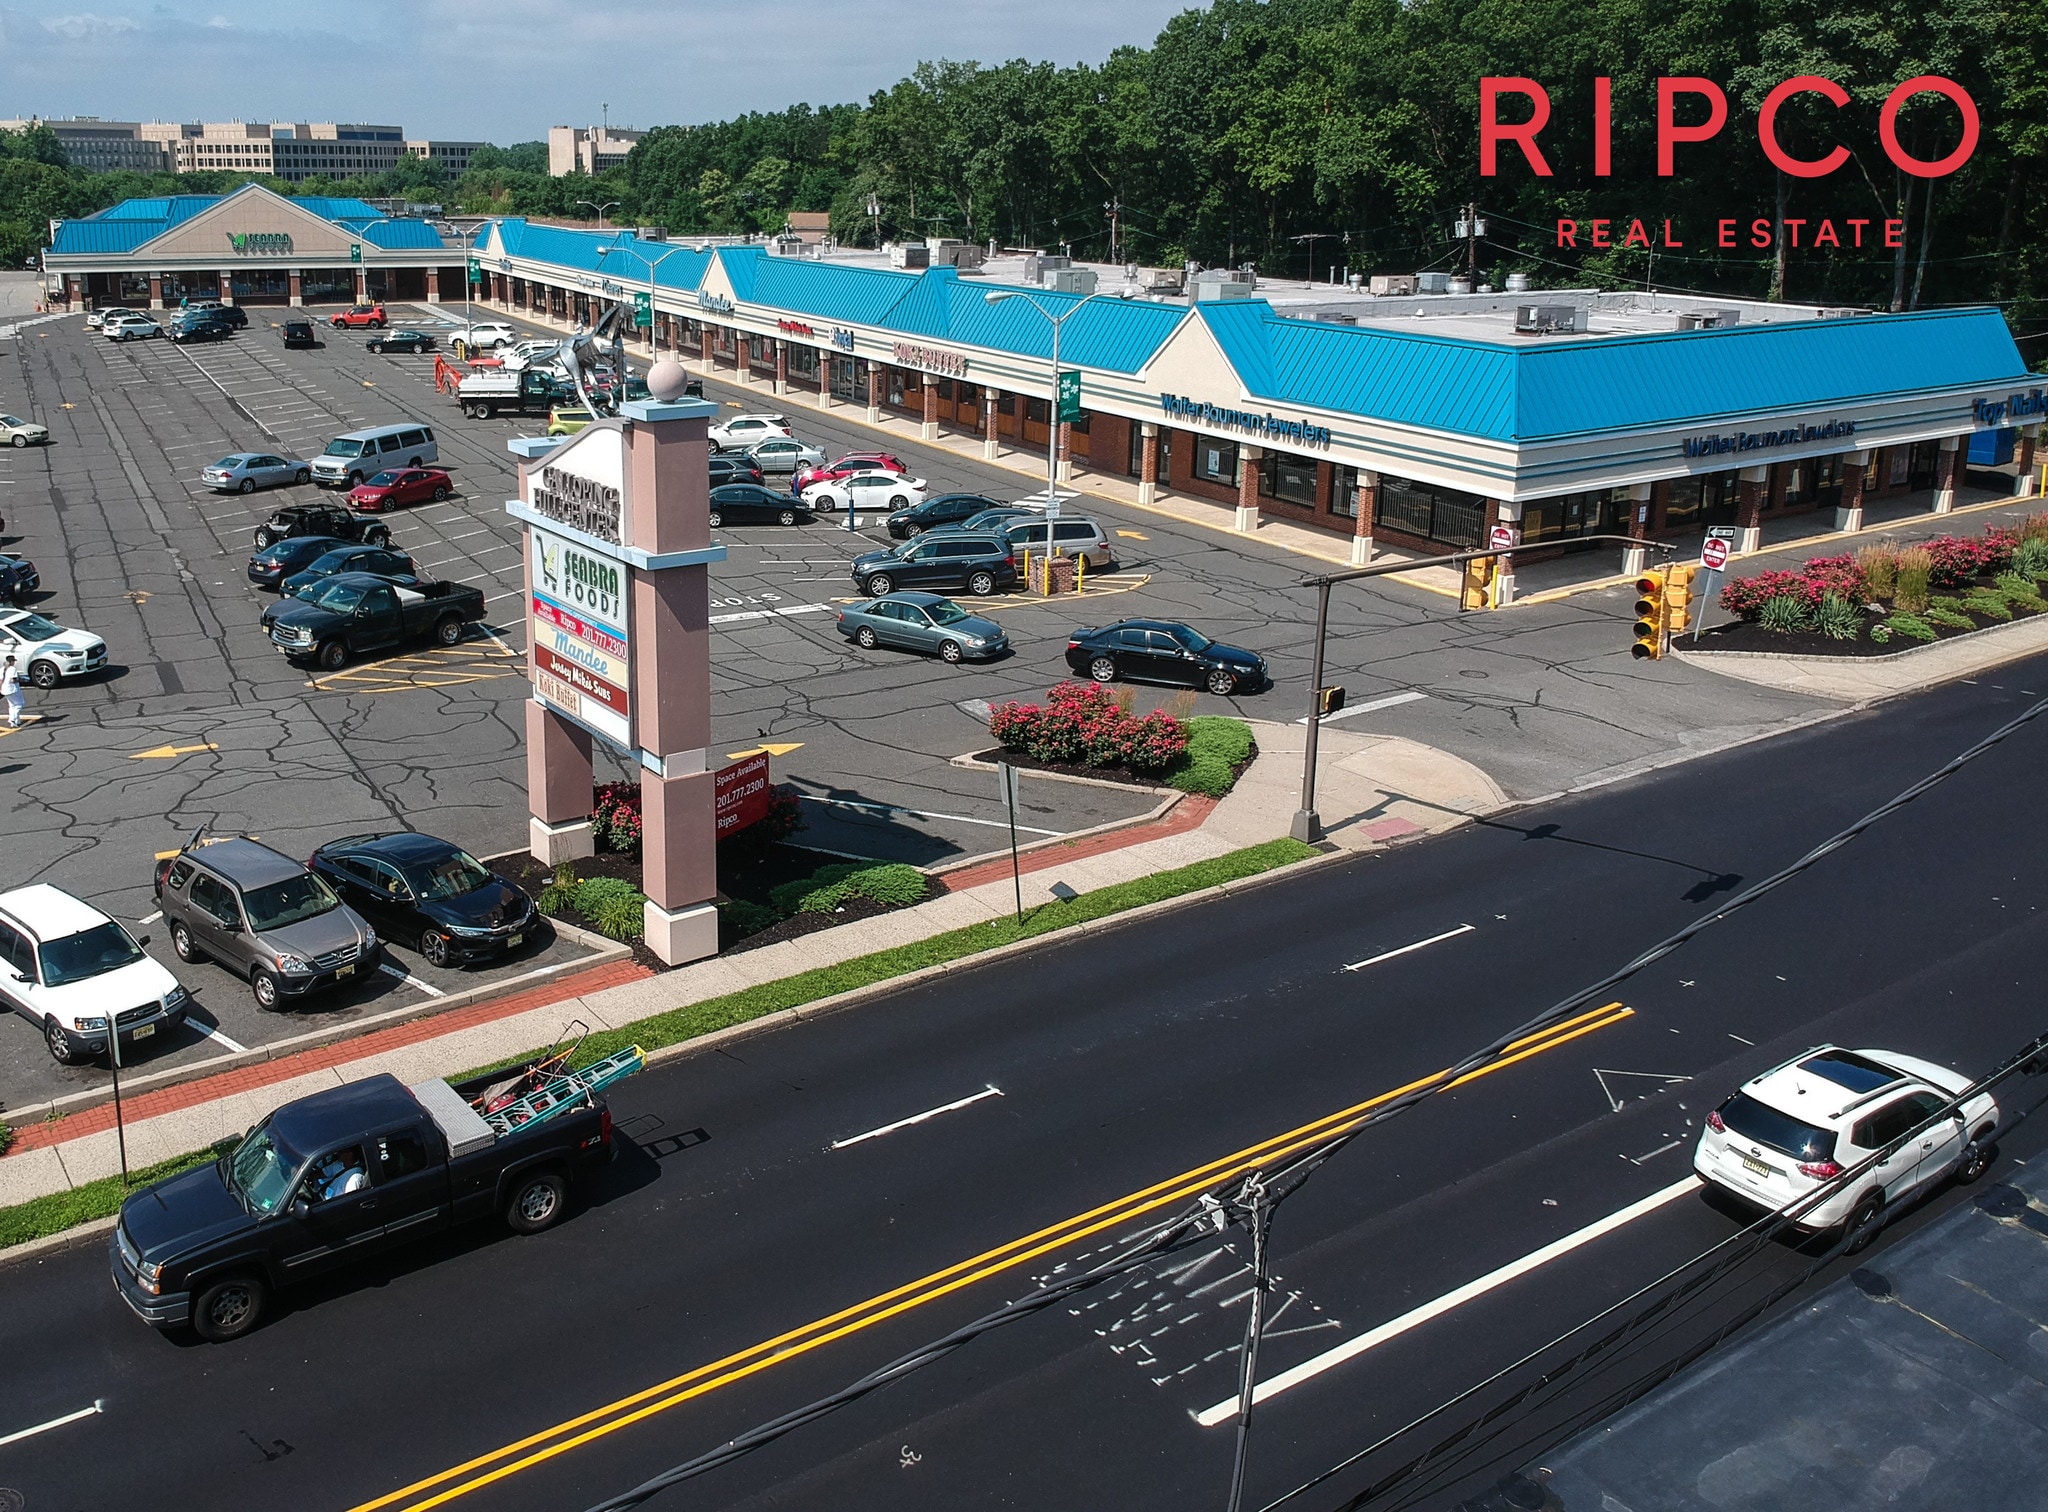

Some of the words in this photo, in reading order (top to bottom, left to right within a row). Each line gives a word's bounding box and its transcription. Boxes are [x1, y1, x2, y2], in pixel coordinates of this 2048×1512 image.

[249, 233, 289, 243] SEABRA
[698, 289, 732, 312] Mandee
[893, 342, 921, 362] KOKI
[922, 347, 964, 371] BUFFET
[1160, 392, 1203, 417] Walter
[1203, 402, 1261, 430] Bauman
[1261, 412, 1331, 444] Jewelers
[1973, 398, 2006, 425] Top
[2009, 389, 2048, 417] Nails
[1683, 433, 1736, 459] Walter
[1737, 427, 1799, 453] Bauman
[1799, 418, 1857, 442] Jewelers
[543, 466, 620, 514] GALLOPING
[563, 500, 622, 546] CENTER
[1706, 555, 1721, 564] ENTER
[1715, 545, 1725, 553] NOT
[565, 550, 619, 597] SEABRA
[566, 579, 619, 618] FOODS
[710, 593, 782, 609] STOP
[550, 627, 608, 676] Mandee
[560, 613, 577, 632] Ripco
[581, 623, 627, 660] 201.777.2300
[550, 655, 572, 683] Jersey
[556, 683, 577, 711] Buffet
[716, 771, 736, 788] Space
[736, 758, 766, 778] Available
[717, 777, 764, 809] 201.777.2300
[717, 813, 738, 829] Ripco
